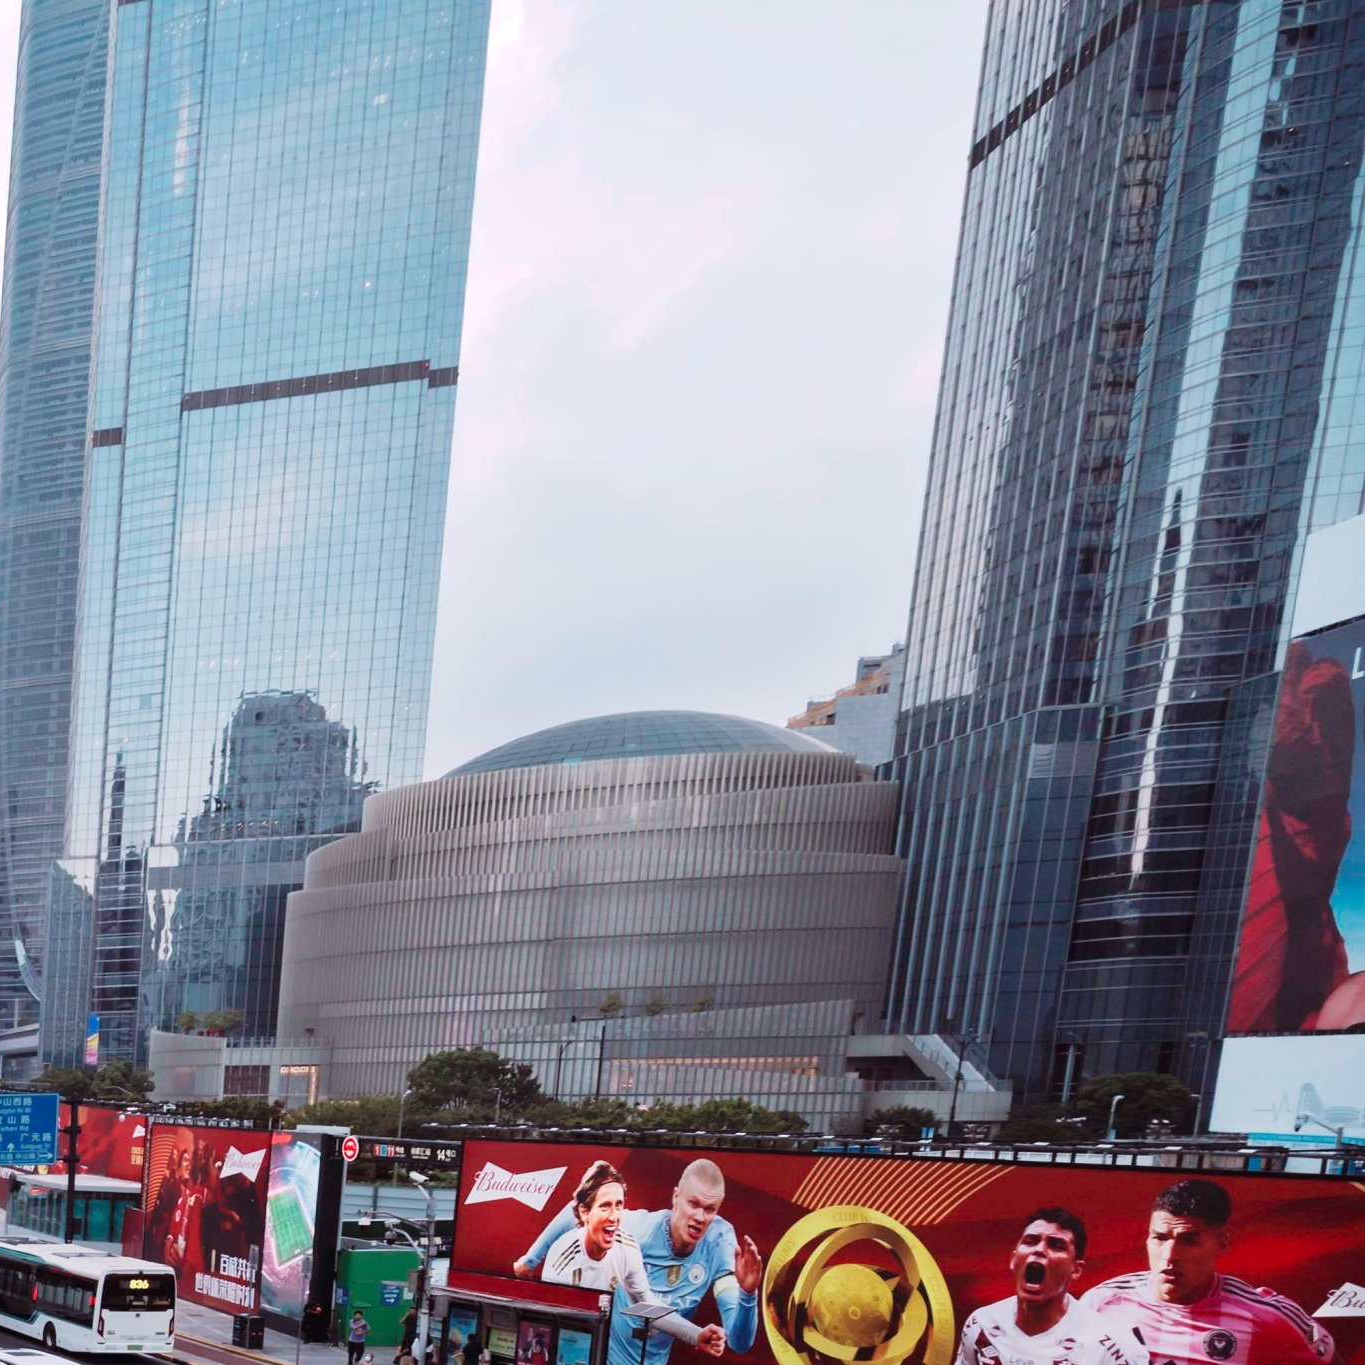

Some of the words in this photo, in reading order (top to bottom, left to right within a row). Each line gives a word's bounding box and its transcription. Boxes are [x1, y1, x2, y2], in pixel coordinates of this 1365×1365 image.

[20, 1133, 52, 1141] 广元路
[474, 1170, 555, 1195] Budweiser
[130, 1279, 149, 1289] 836
